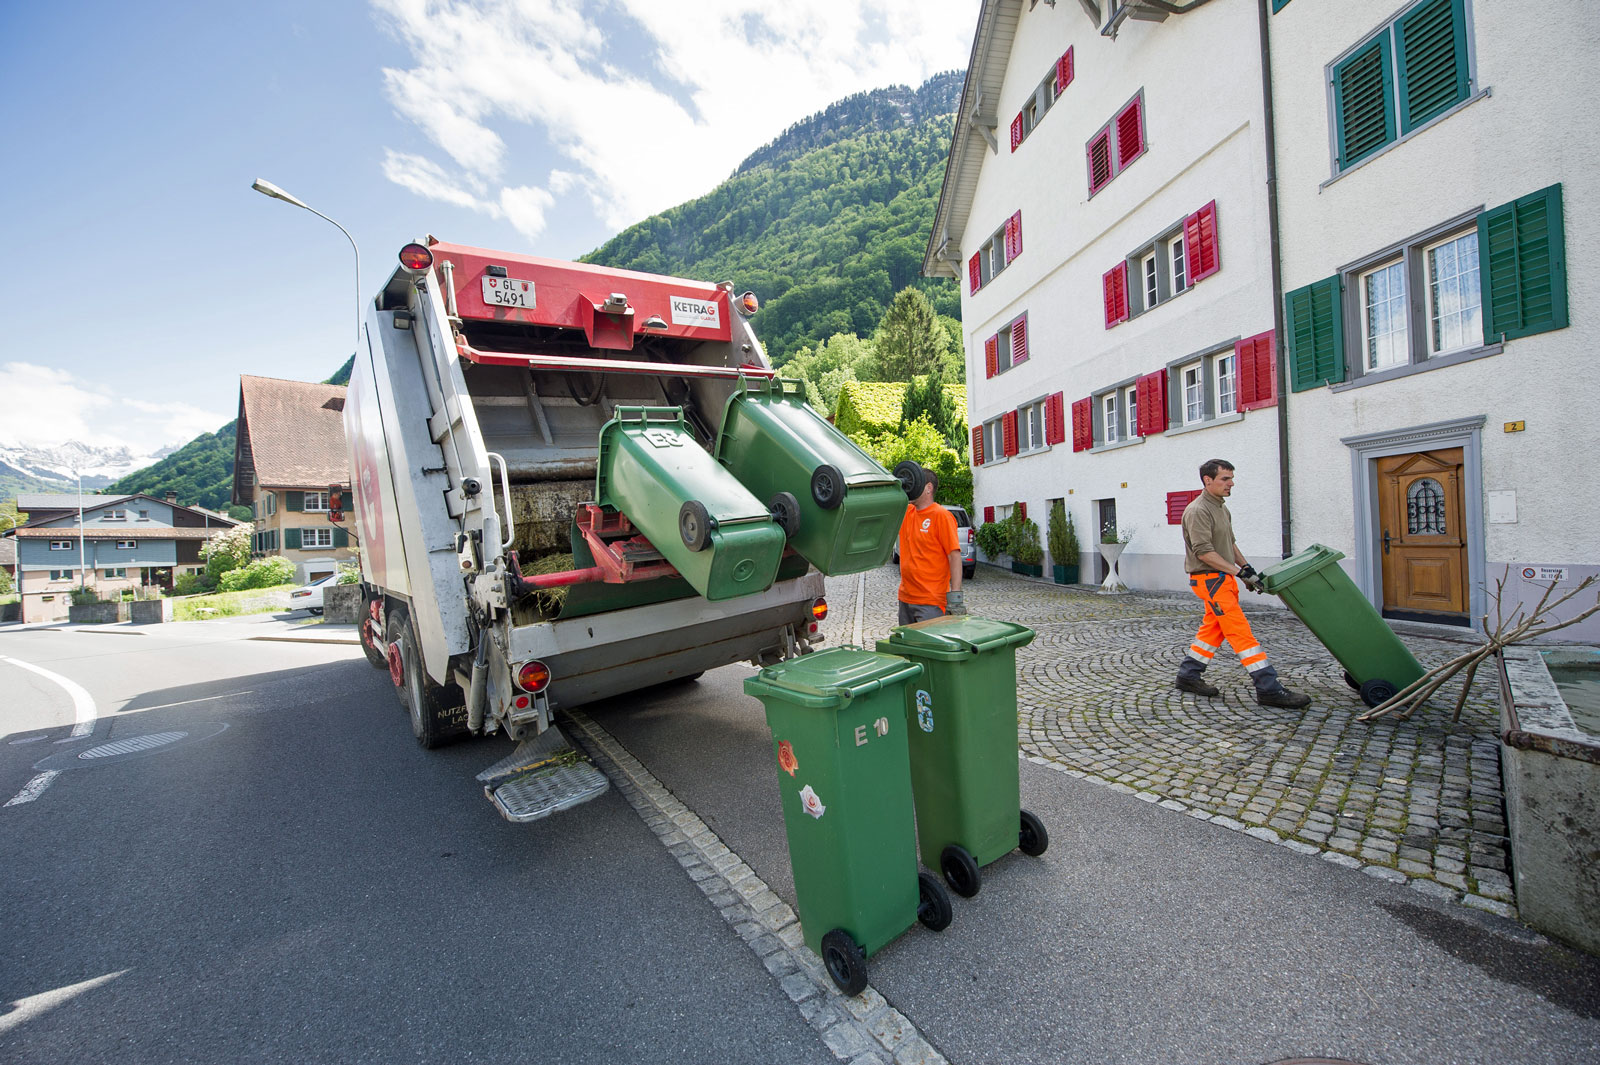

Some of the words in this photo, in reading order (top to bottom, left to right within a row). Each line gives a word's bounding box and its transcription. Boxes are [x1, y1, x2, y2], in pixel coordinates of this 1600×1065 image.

[503, 280, 516, 291] GL
[495, 290, 525, 306] 5491
[674, 301, 715, 315] KETRAG
[642, 431, 683, 448] E8
[916, 689, 934, 733] 6
[854, 724, 868, 747] E
[873, 716, 889, 738] 10
